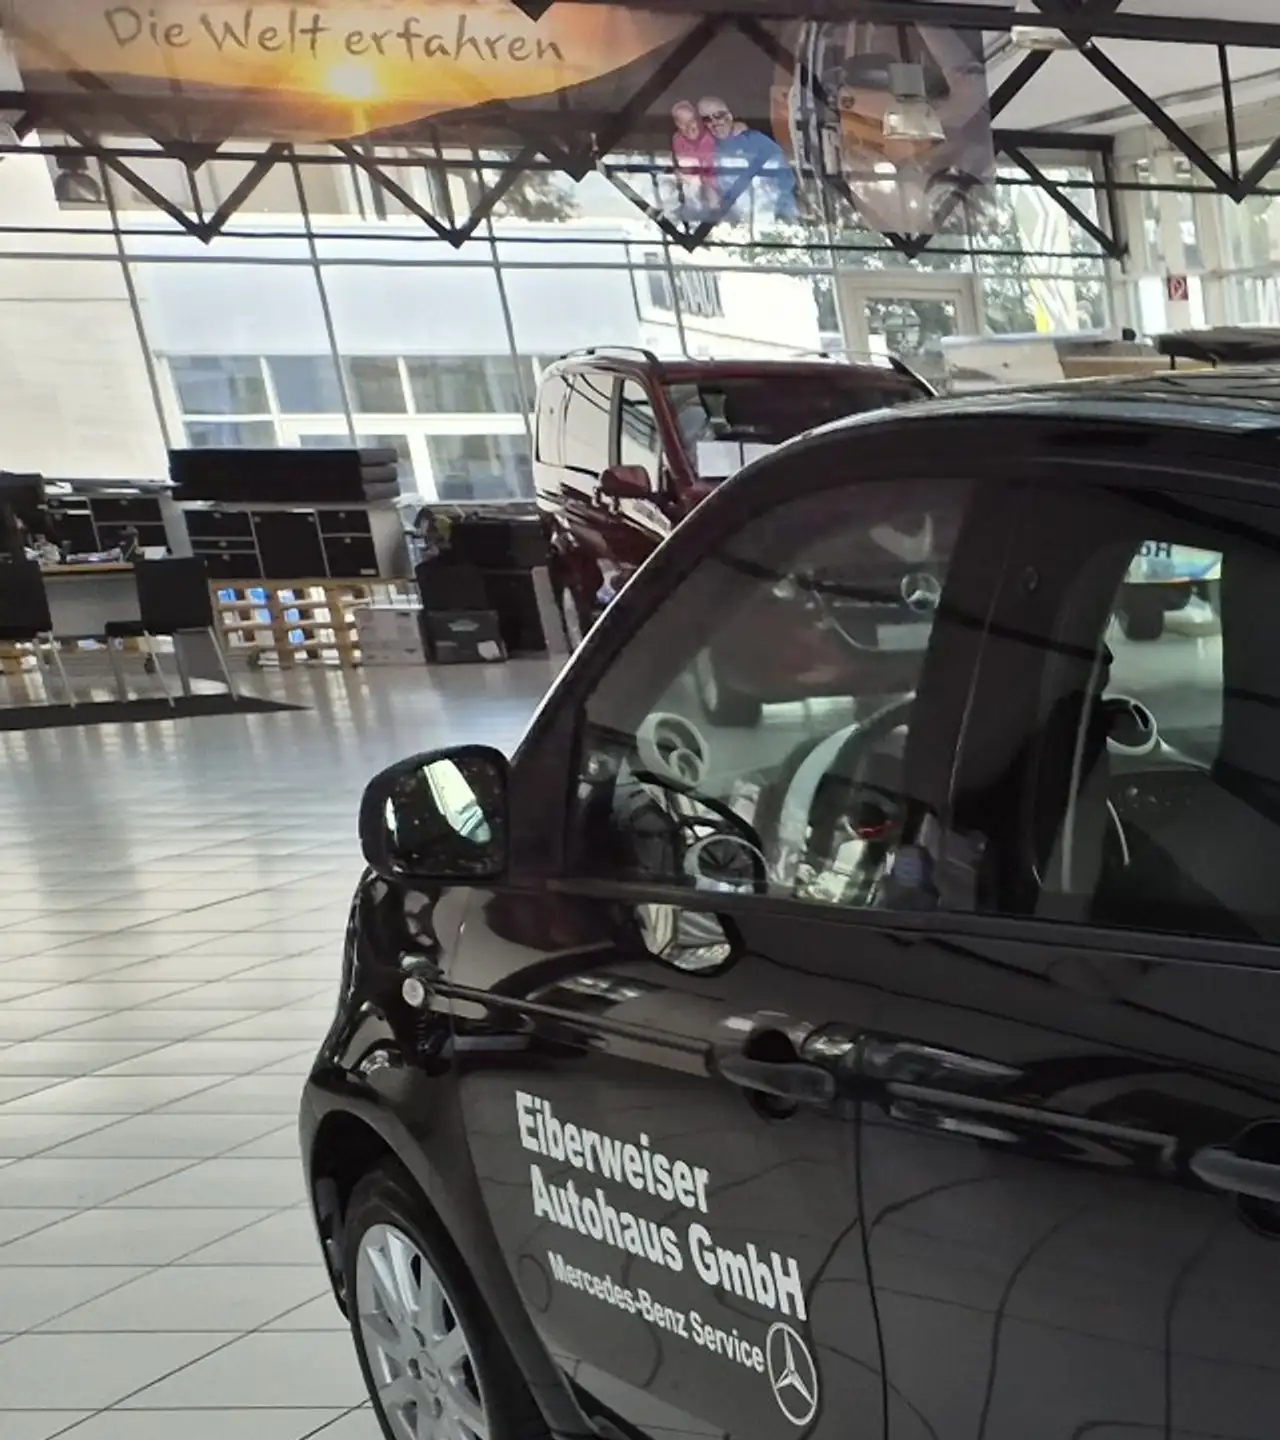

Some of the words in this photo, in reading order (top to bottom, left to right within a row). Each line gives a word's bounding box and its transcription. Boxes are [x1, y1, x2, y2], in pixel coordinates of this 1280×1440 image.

[104, 6, 191, 48] Die
[201, 9, 330, 60] Welt
[345, 14, 566, 63] erfahren
[516, 1090, 709, 1212] Eiberweiser
[530, 1163, 683, 1271] Autohaus
[688, 1222, 807, 1321] GmbH
[547, 1250, 689, 1338] Mercedes-Benz
[690, 1310, 765, 1373] Service
